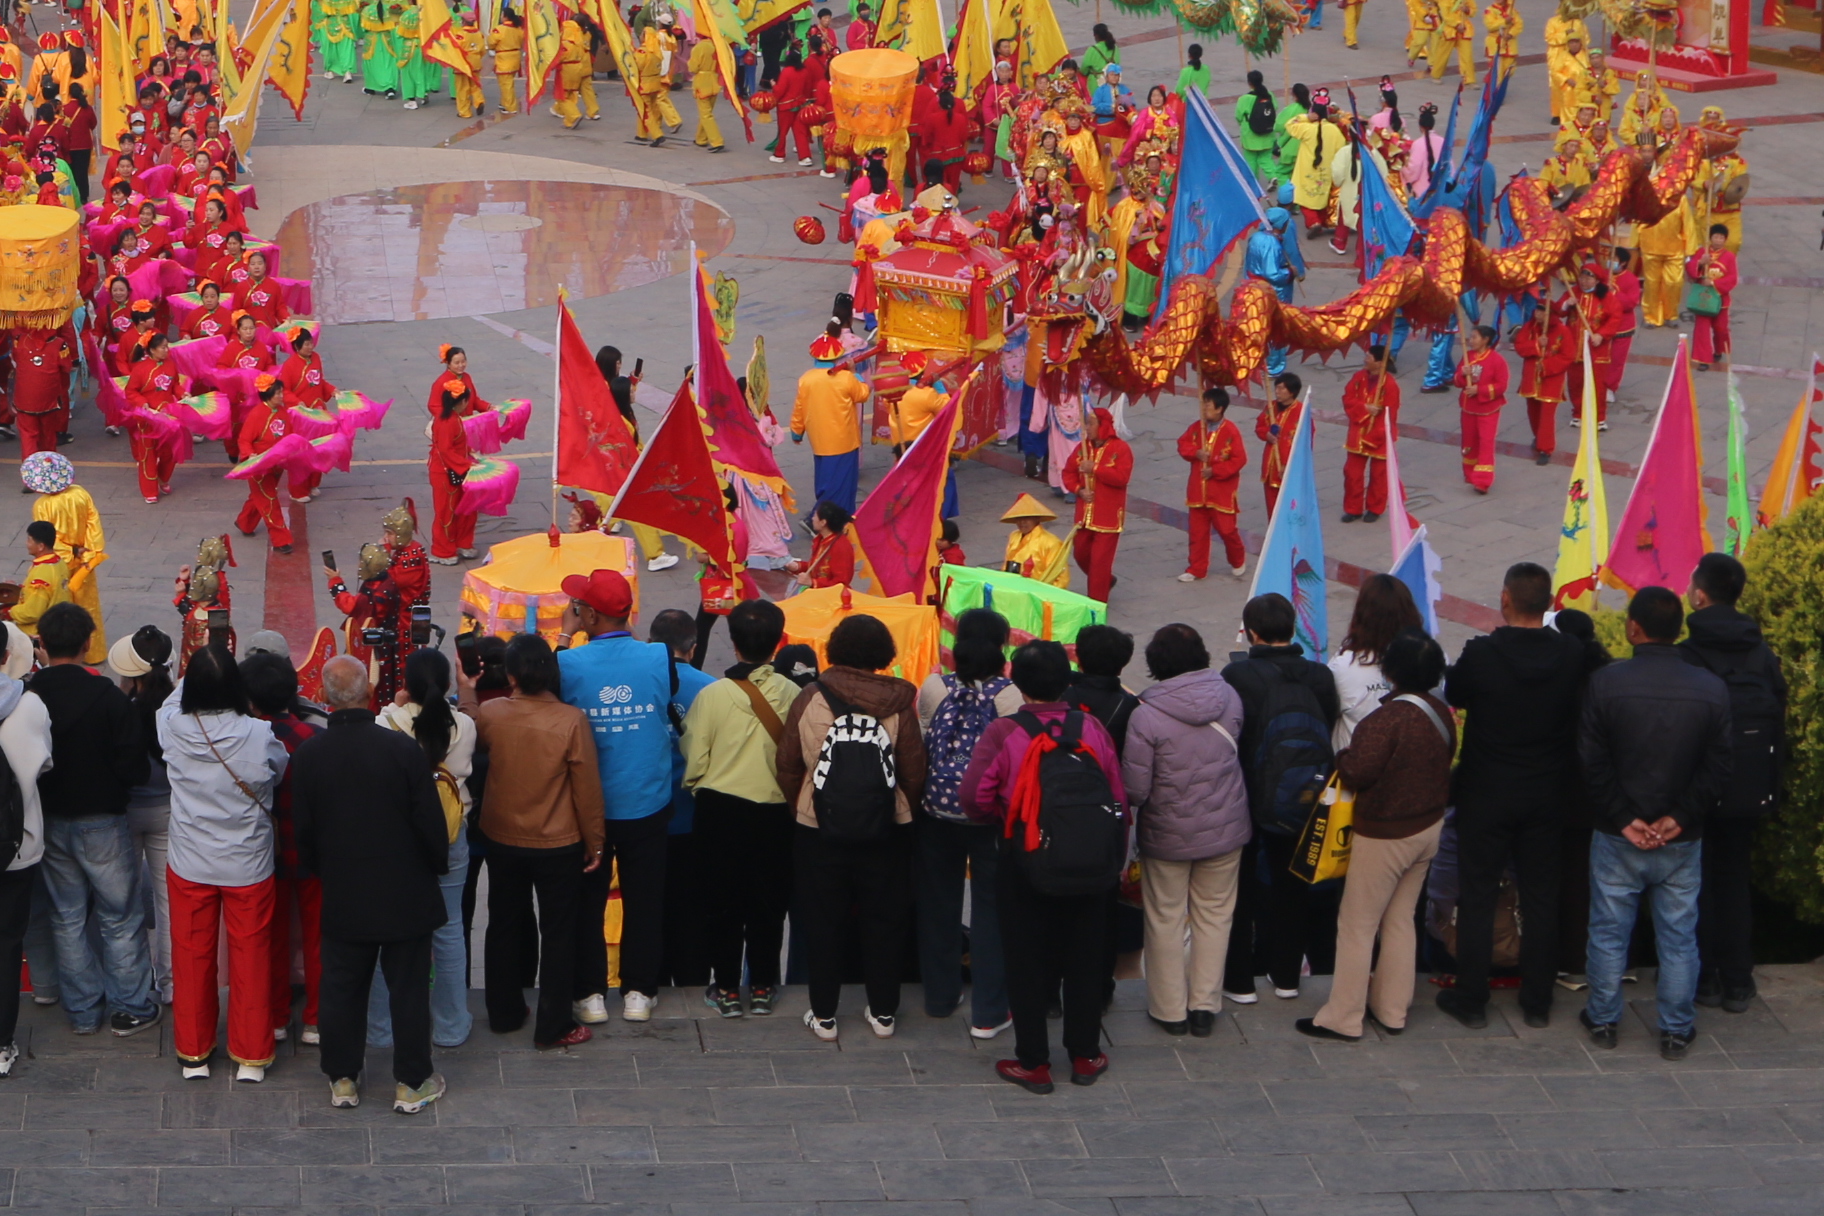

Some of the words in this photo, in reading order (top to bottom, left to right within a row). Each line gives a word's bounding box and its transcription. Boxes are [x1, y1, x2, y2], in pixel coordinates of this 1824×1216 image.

[581, 703, 655, 717] 县新媒体协会
